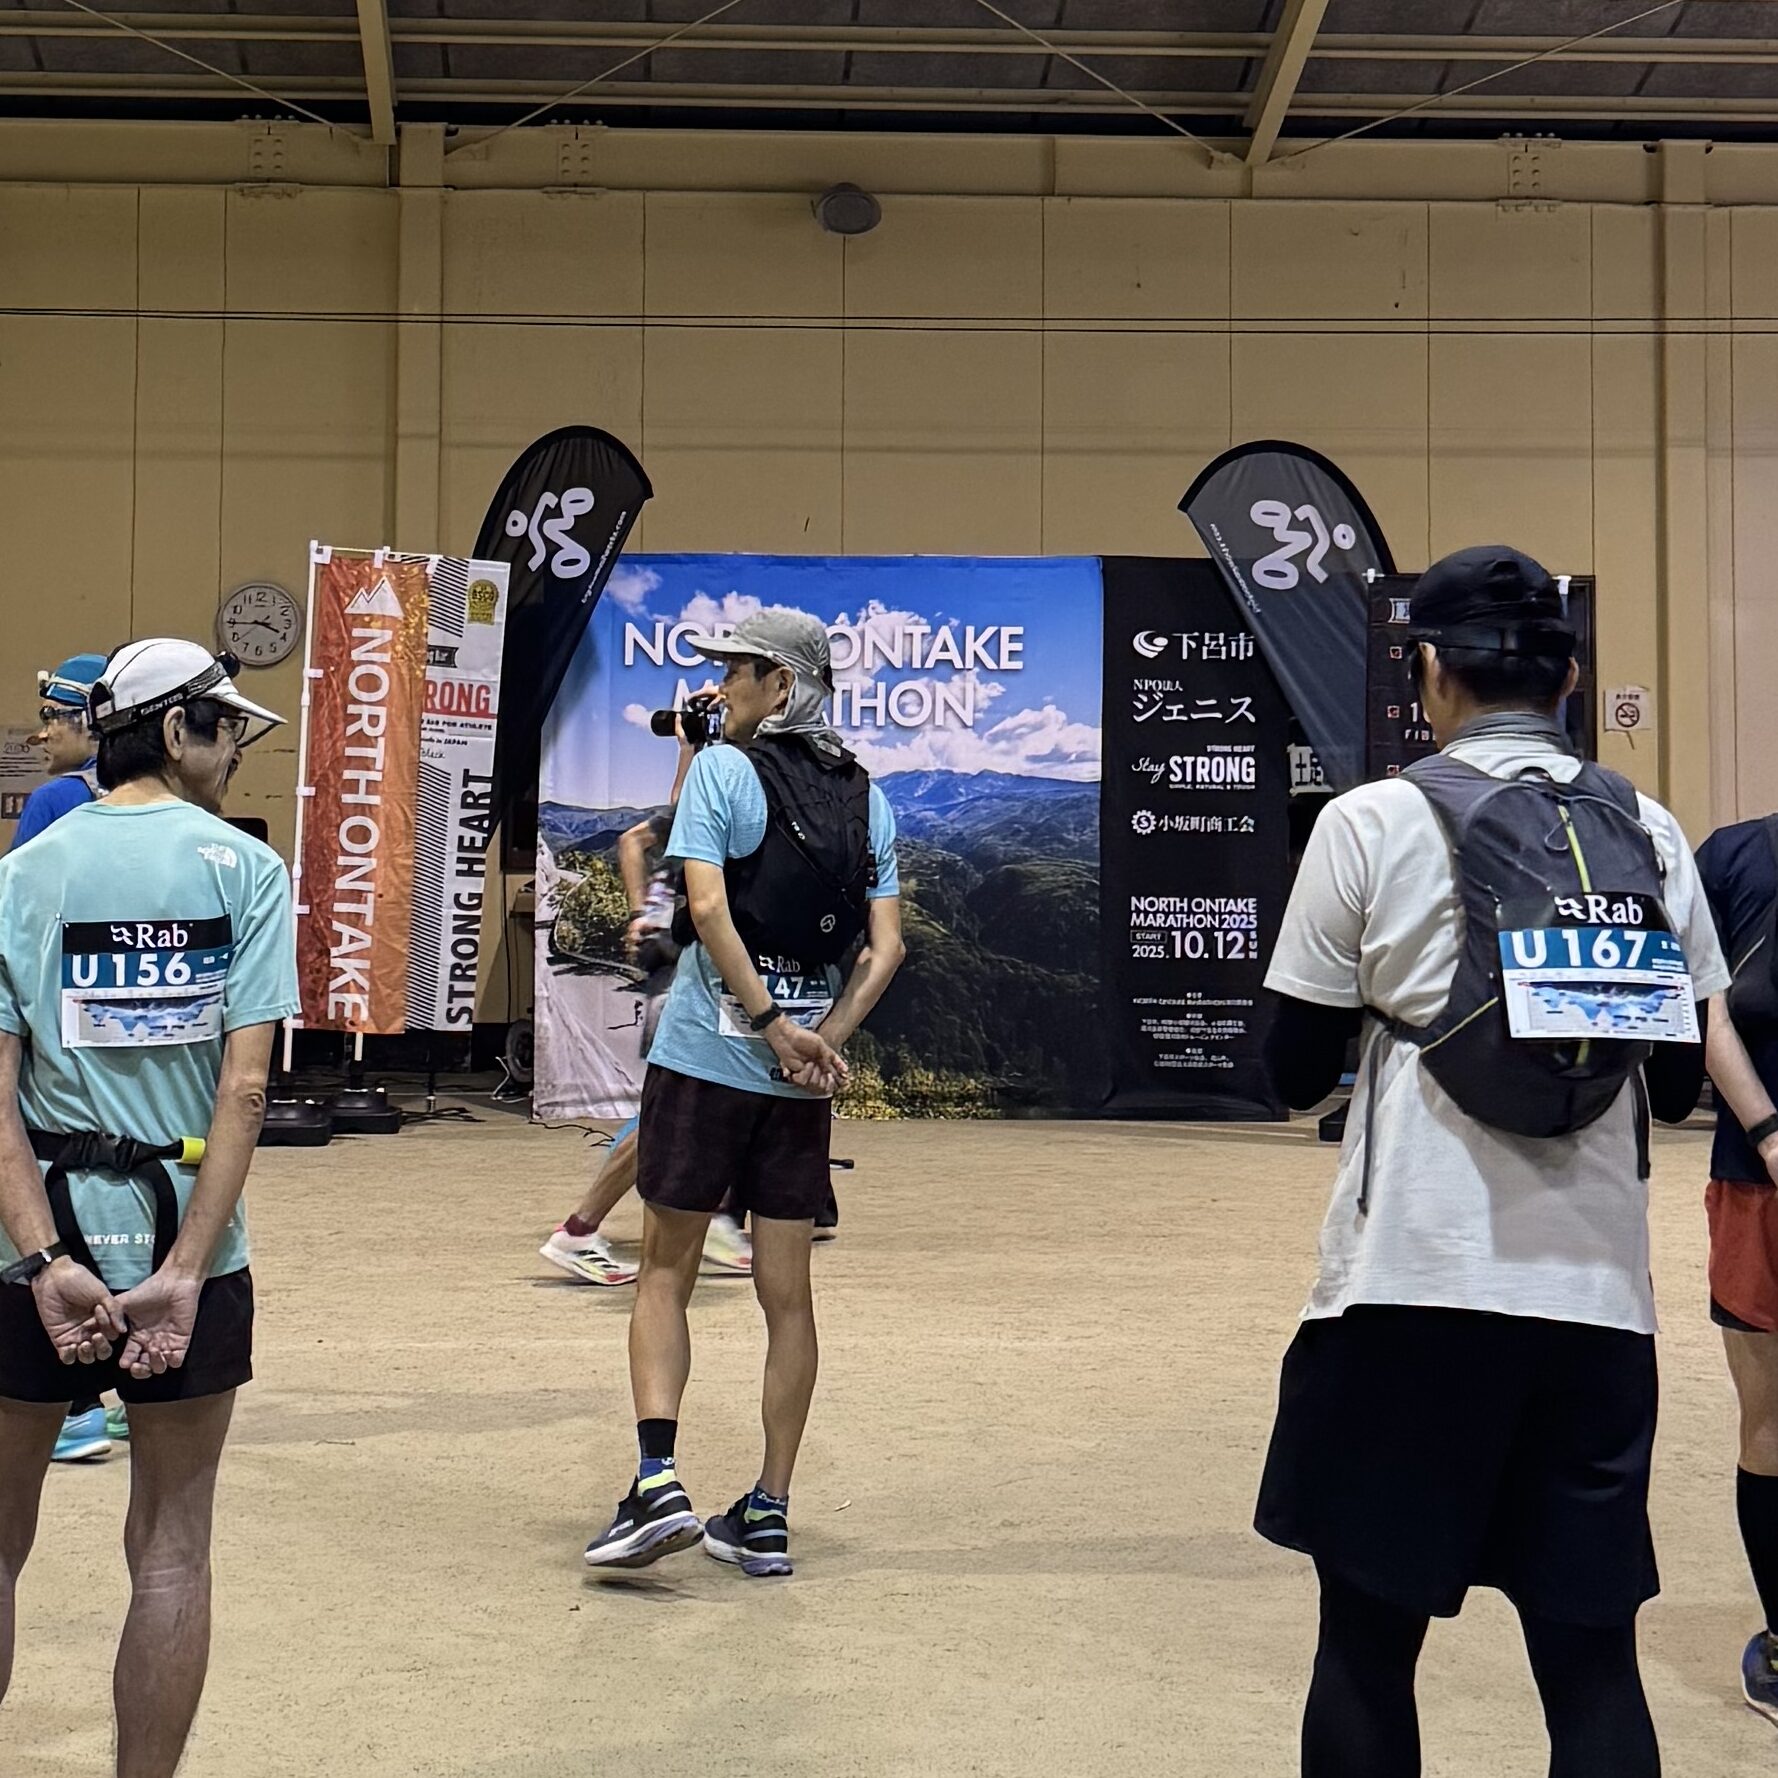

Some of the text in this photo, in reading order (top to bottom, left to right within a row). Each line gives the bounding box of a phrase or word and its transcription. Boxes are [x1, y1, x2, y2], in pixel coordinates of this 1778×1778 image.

[826, 625, 1024, 670] ONTAKE
[1172, 632, 1255, 660] 下呂市
[424, 680, 491, 714] RONG
[1133, 692, 1255, 723] ジェニス
[1131, 757, 1165, 784] Stay
[1169, 755, 1255, 783] STRONG
[327, 627, 393, 1022] NORTH ONTAKE
[445, 768, 494, 1025] STRONG HEART
[1130, 896, 1257, 913] NORTH ONTAKE
[1585, 894, 1643, 925] Rab
[1130, 913, 1257, 929] MARATHON 2025
[136, 923, 188, 949] Rab
[776, 955, 801, 973] Rab
[766, 975, 804, 998] 47
